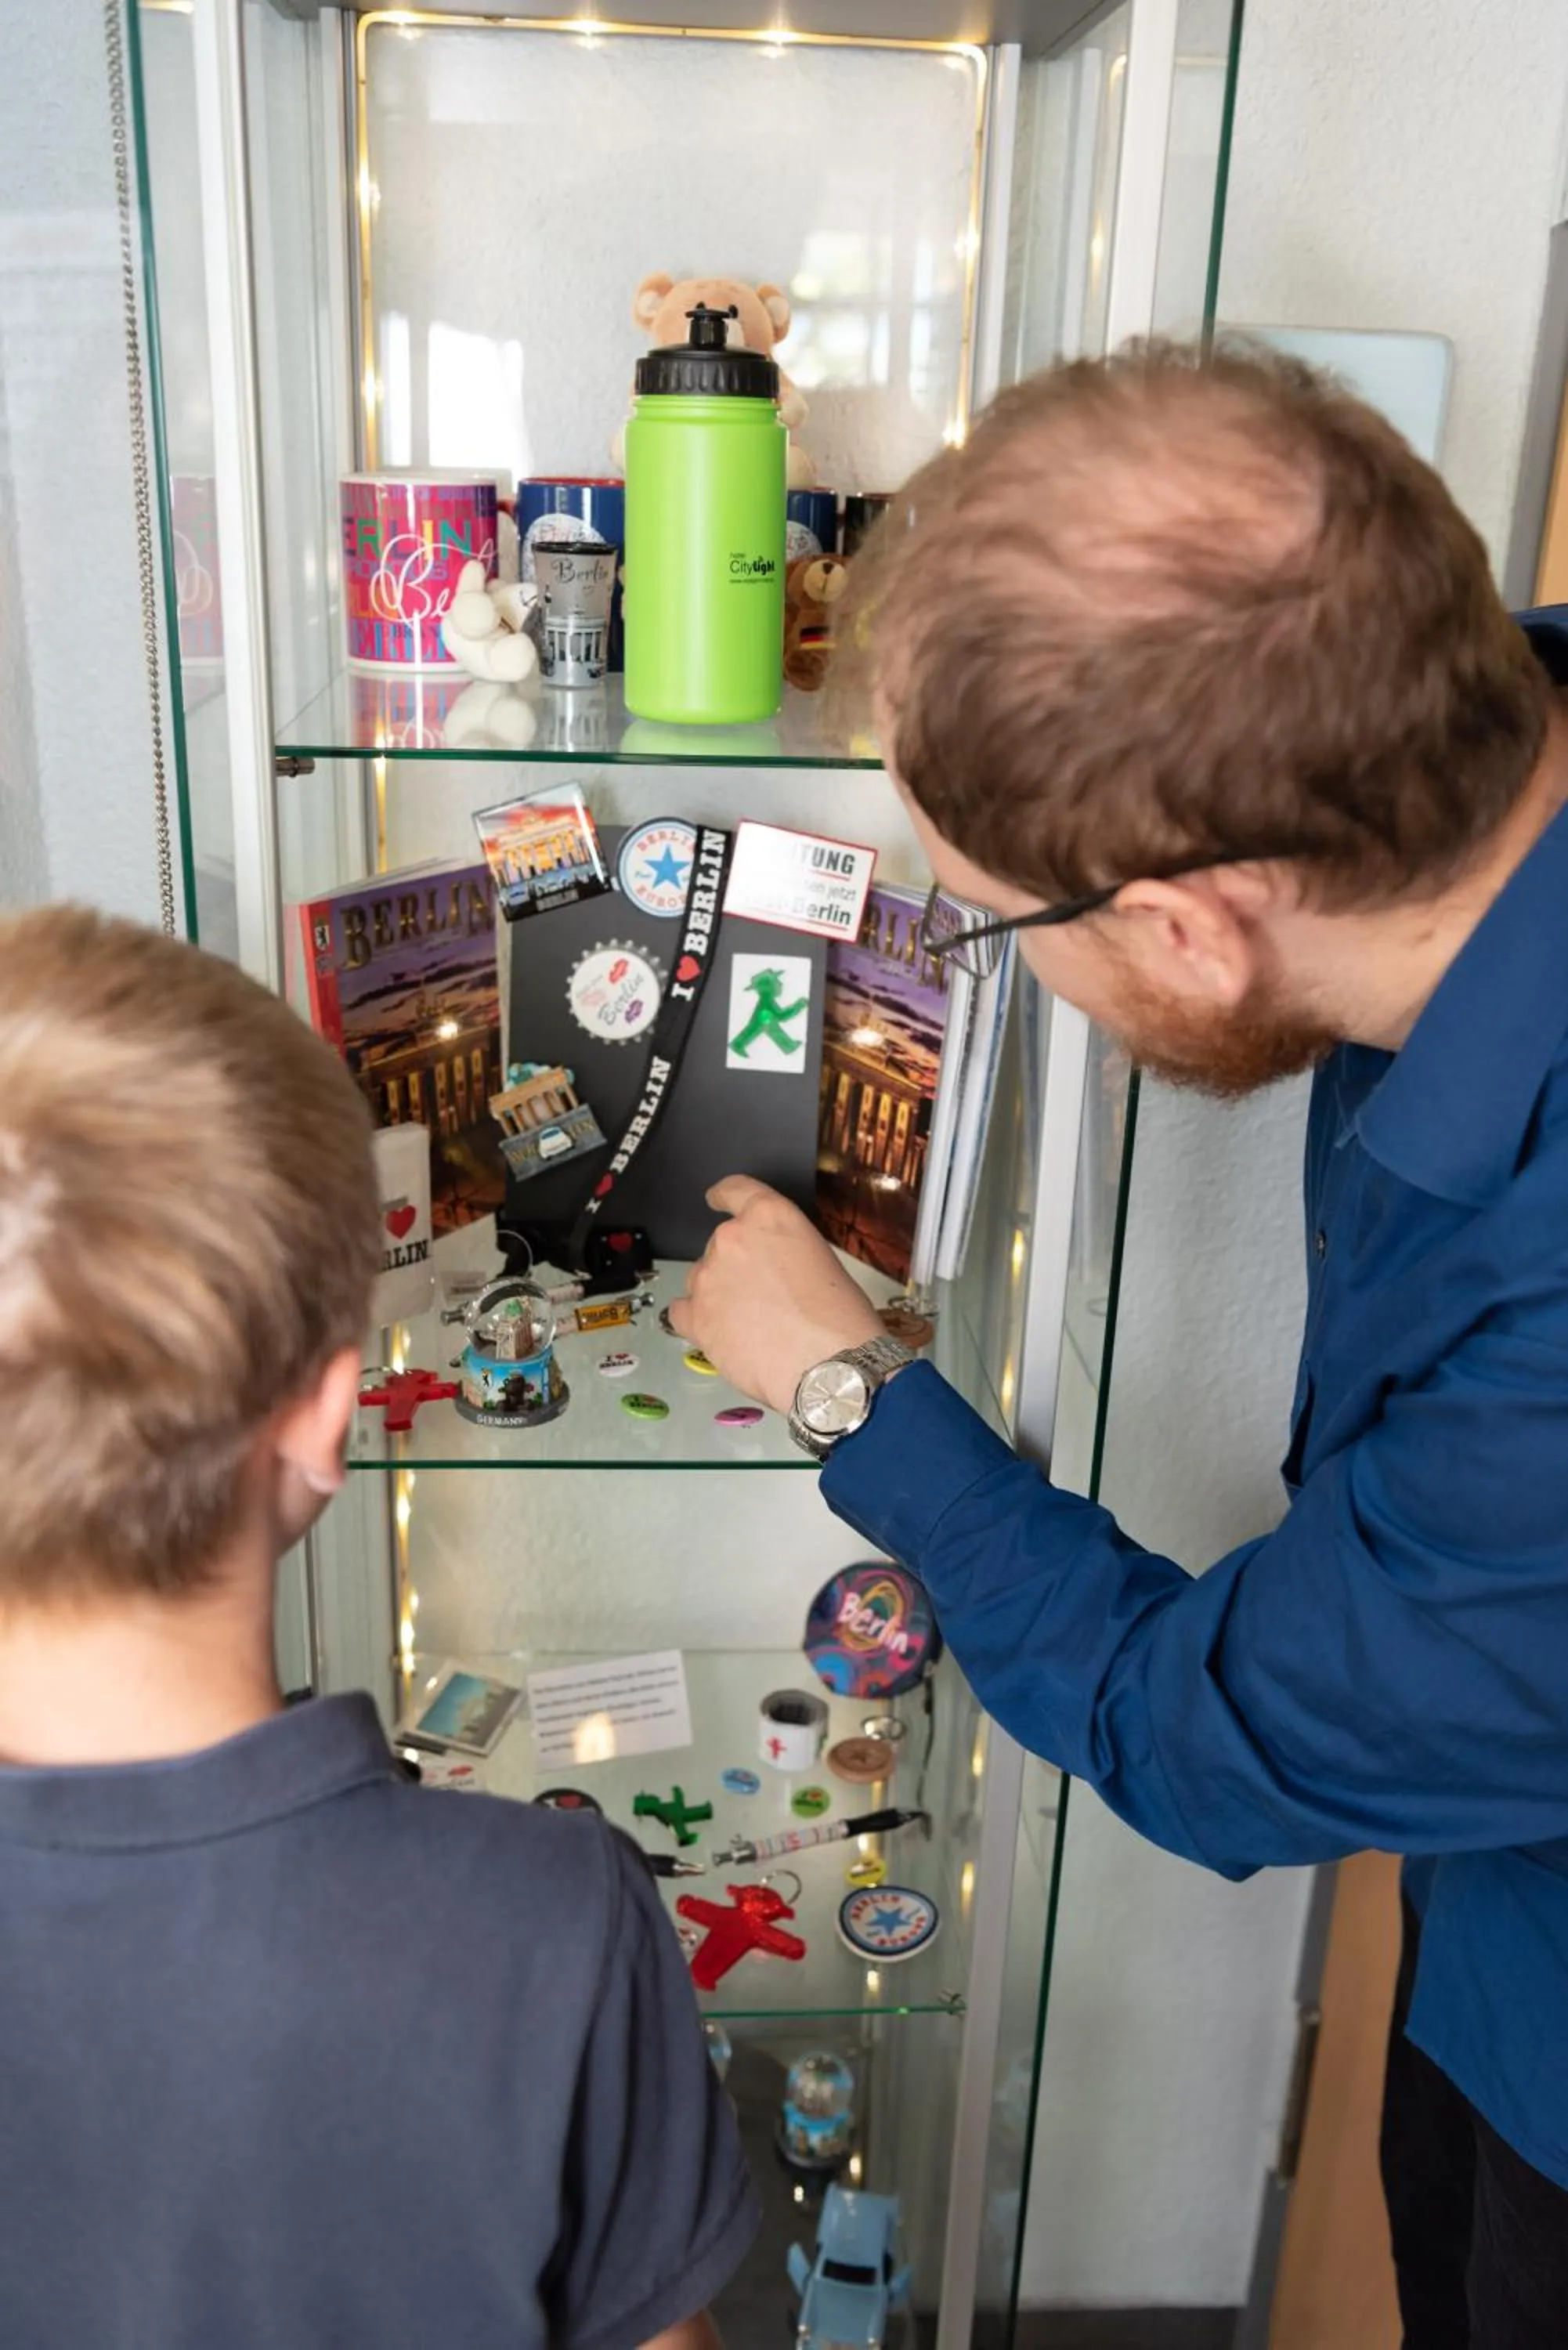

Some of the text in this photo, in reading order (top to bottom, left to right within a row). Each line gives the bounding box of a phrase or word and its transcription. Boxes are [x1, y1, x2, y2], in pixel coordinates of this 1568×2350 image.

[670, 829, 727, 1002] I BERLIN
[585, 1055, 672, 1214] I BERLIN
[838, 1591, 909, 1655] Berlin
